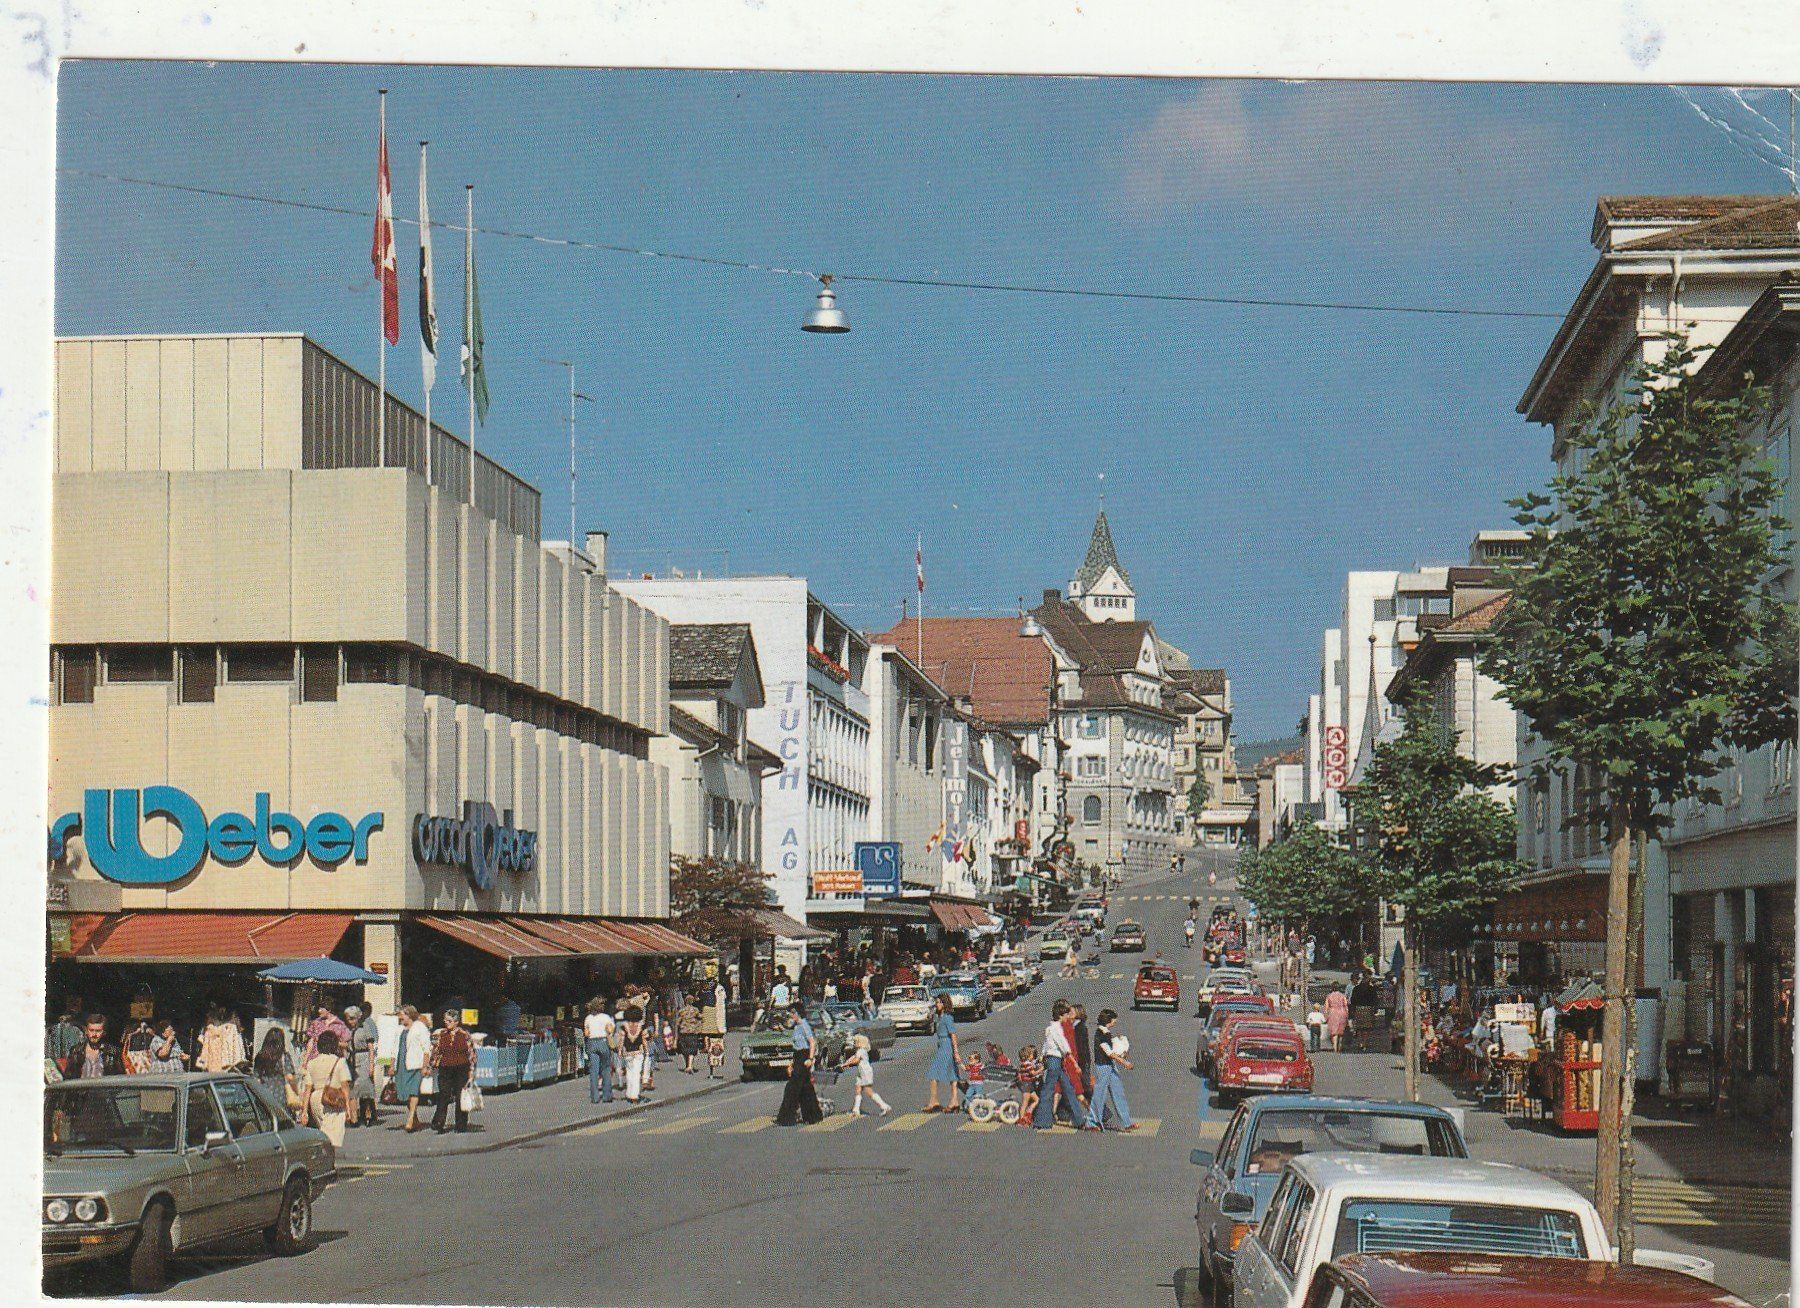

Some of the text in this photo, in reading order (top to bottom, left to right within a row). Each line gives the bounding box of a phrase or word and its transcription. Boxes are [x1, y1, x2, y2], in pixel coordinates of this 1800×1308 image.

[779, 680, 801, 871] TUCH AG
[946, 726, 967, 825] Jelmol
[84, 785, 384, 883] Weber
